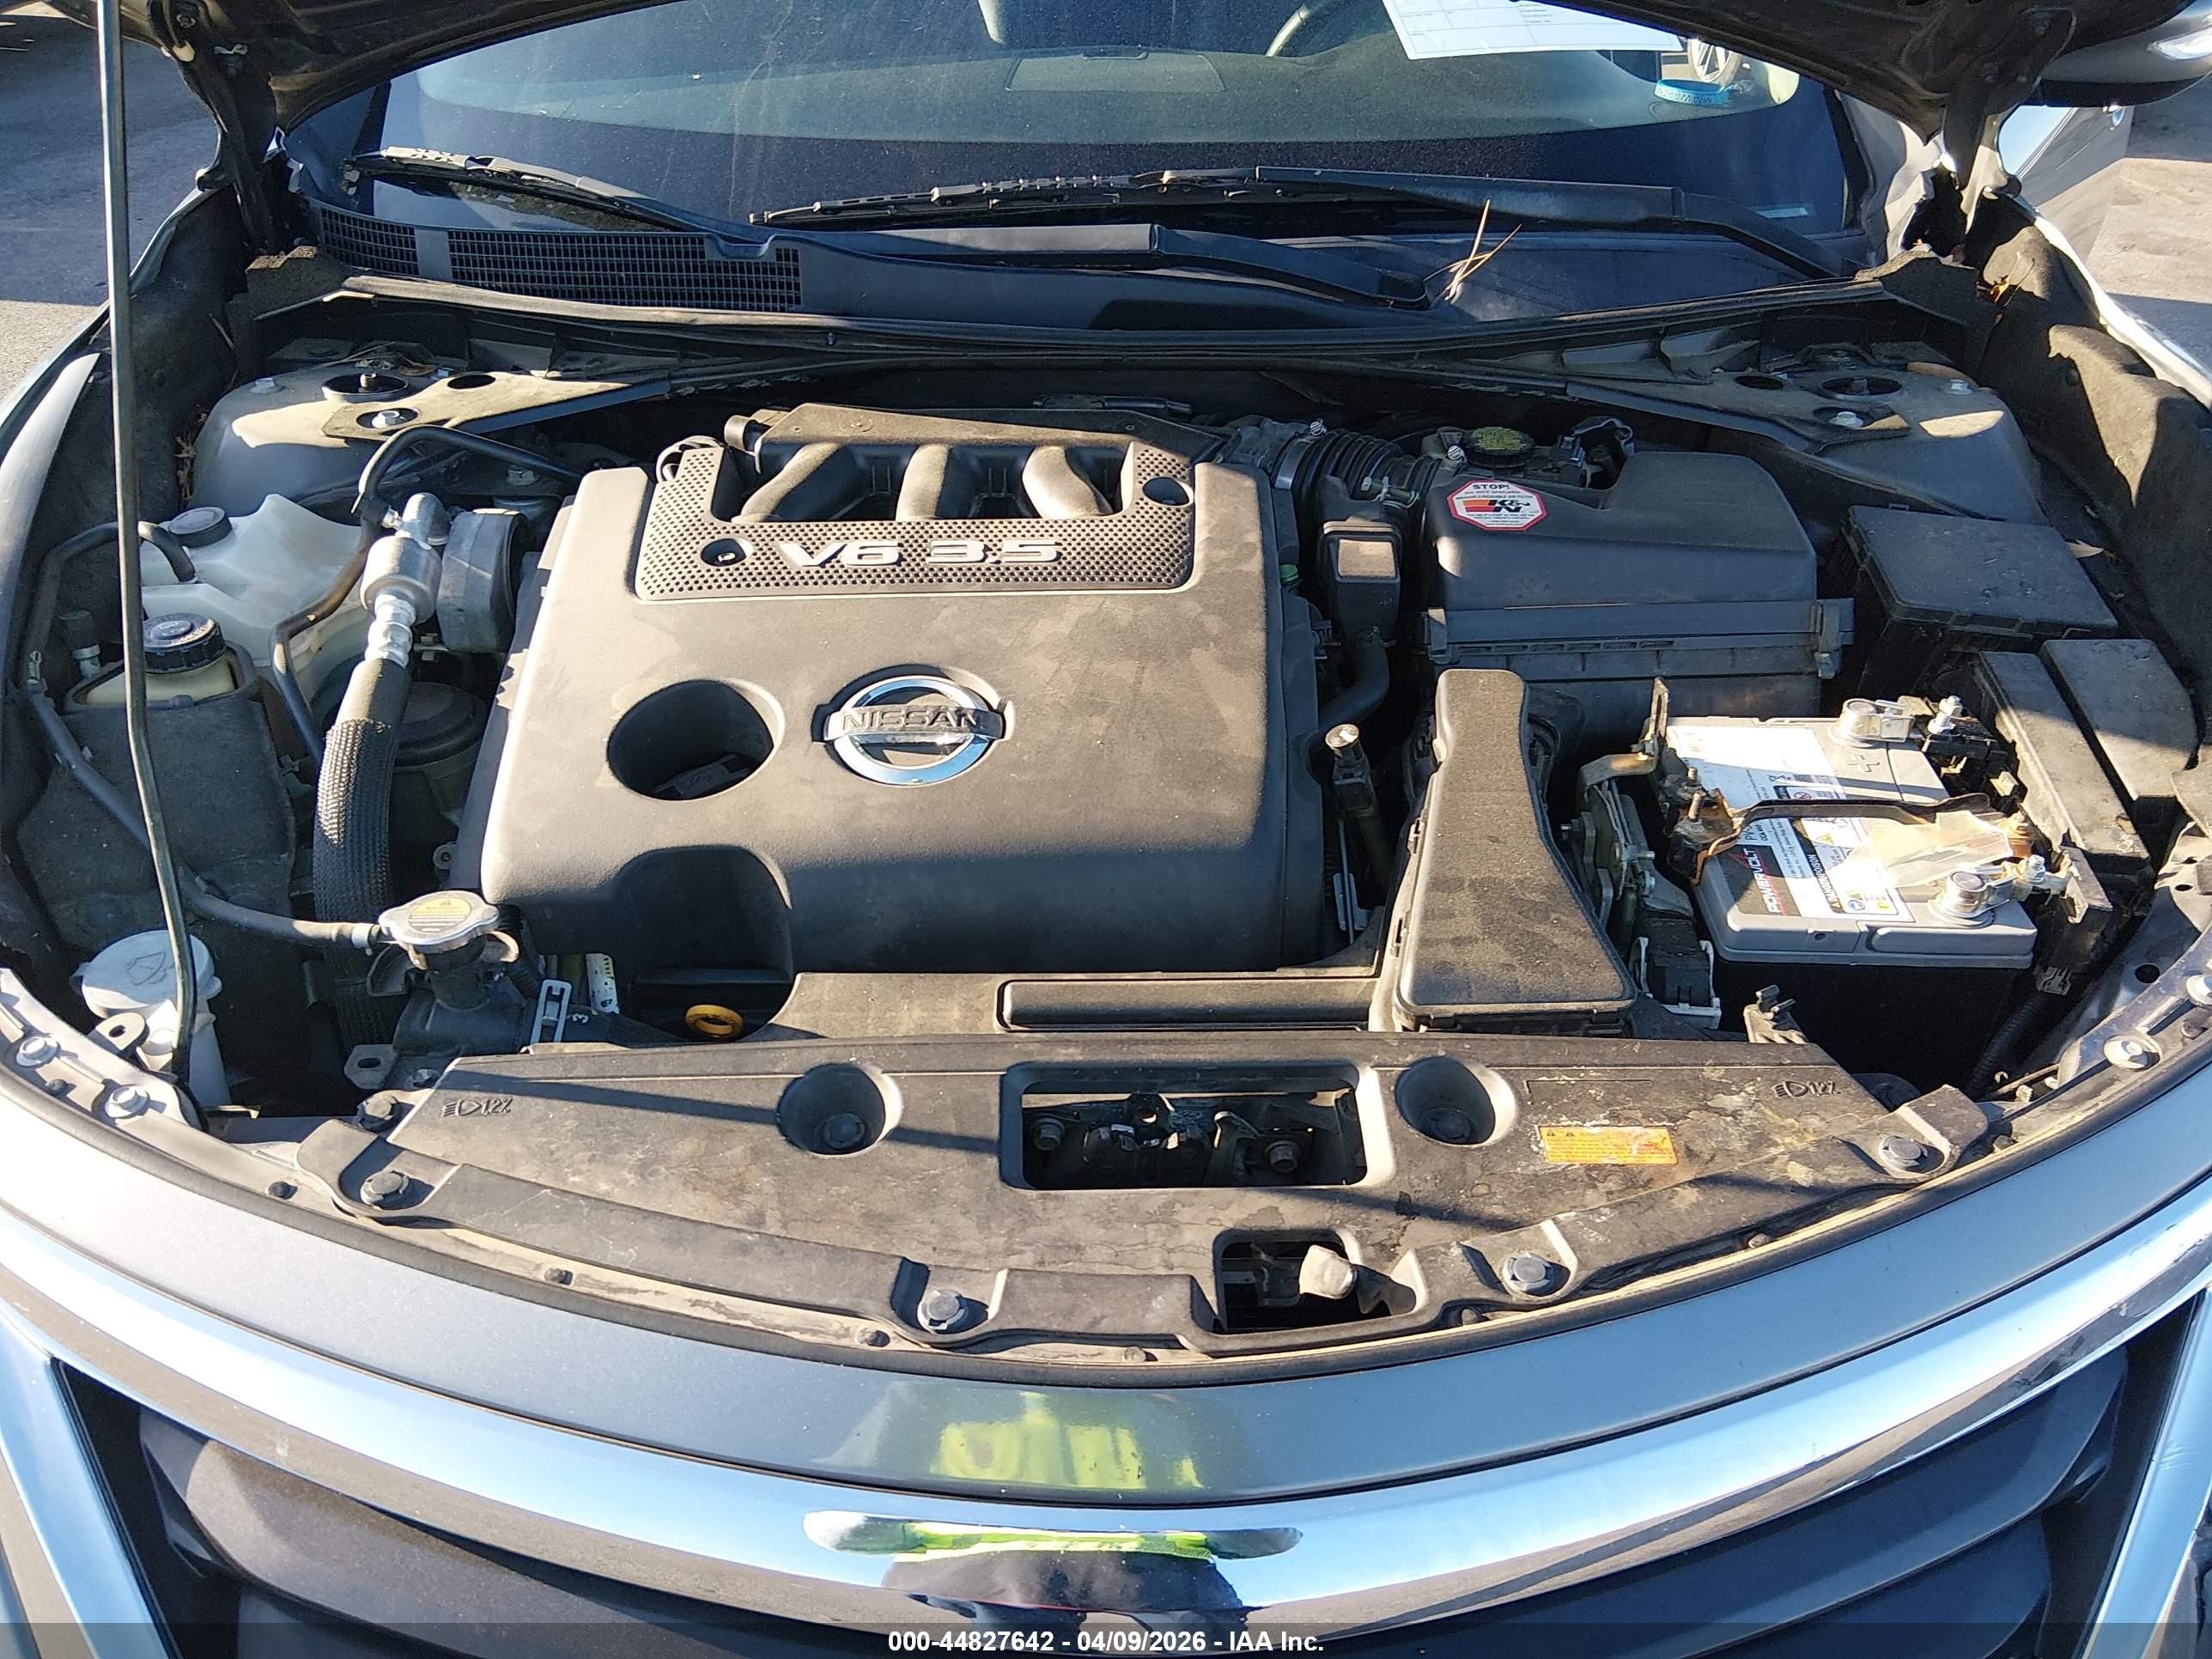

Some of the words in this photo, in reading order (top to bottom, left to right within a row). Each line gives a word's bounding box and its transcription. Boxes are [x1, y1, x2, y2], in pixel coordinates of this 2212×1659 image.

[1488, 499, 1530, 513] K&N
[775, 539, 902, 568] V6
[927, 539, 1063, 566] 3.5
[842, 709, 983, 731] NISSAN
[1742, 848, 1783, 914] POWERVOLT
